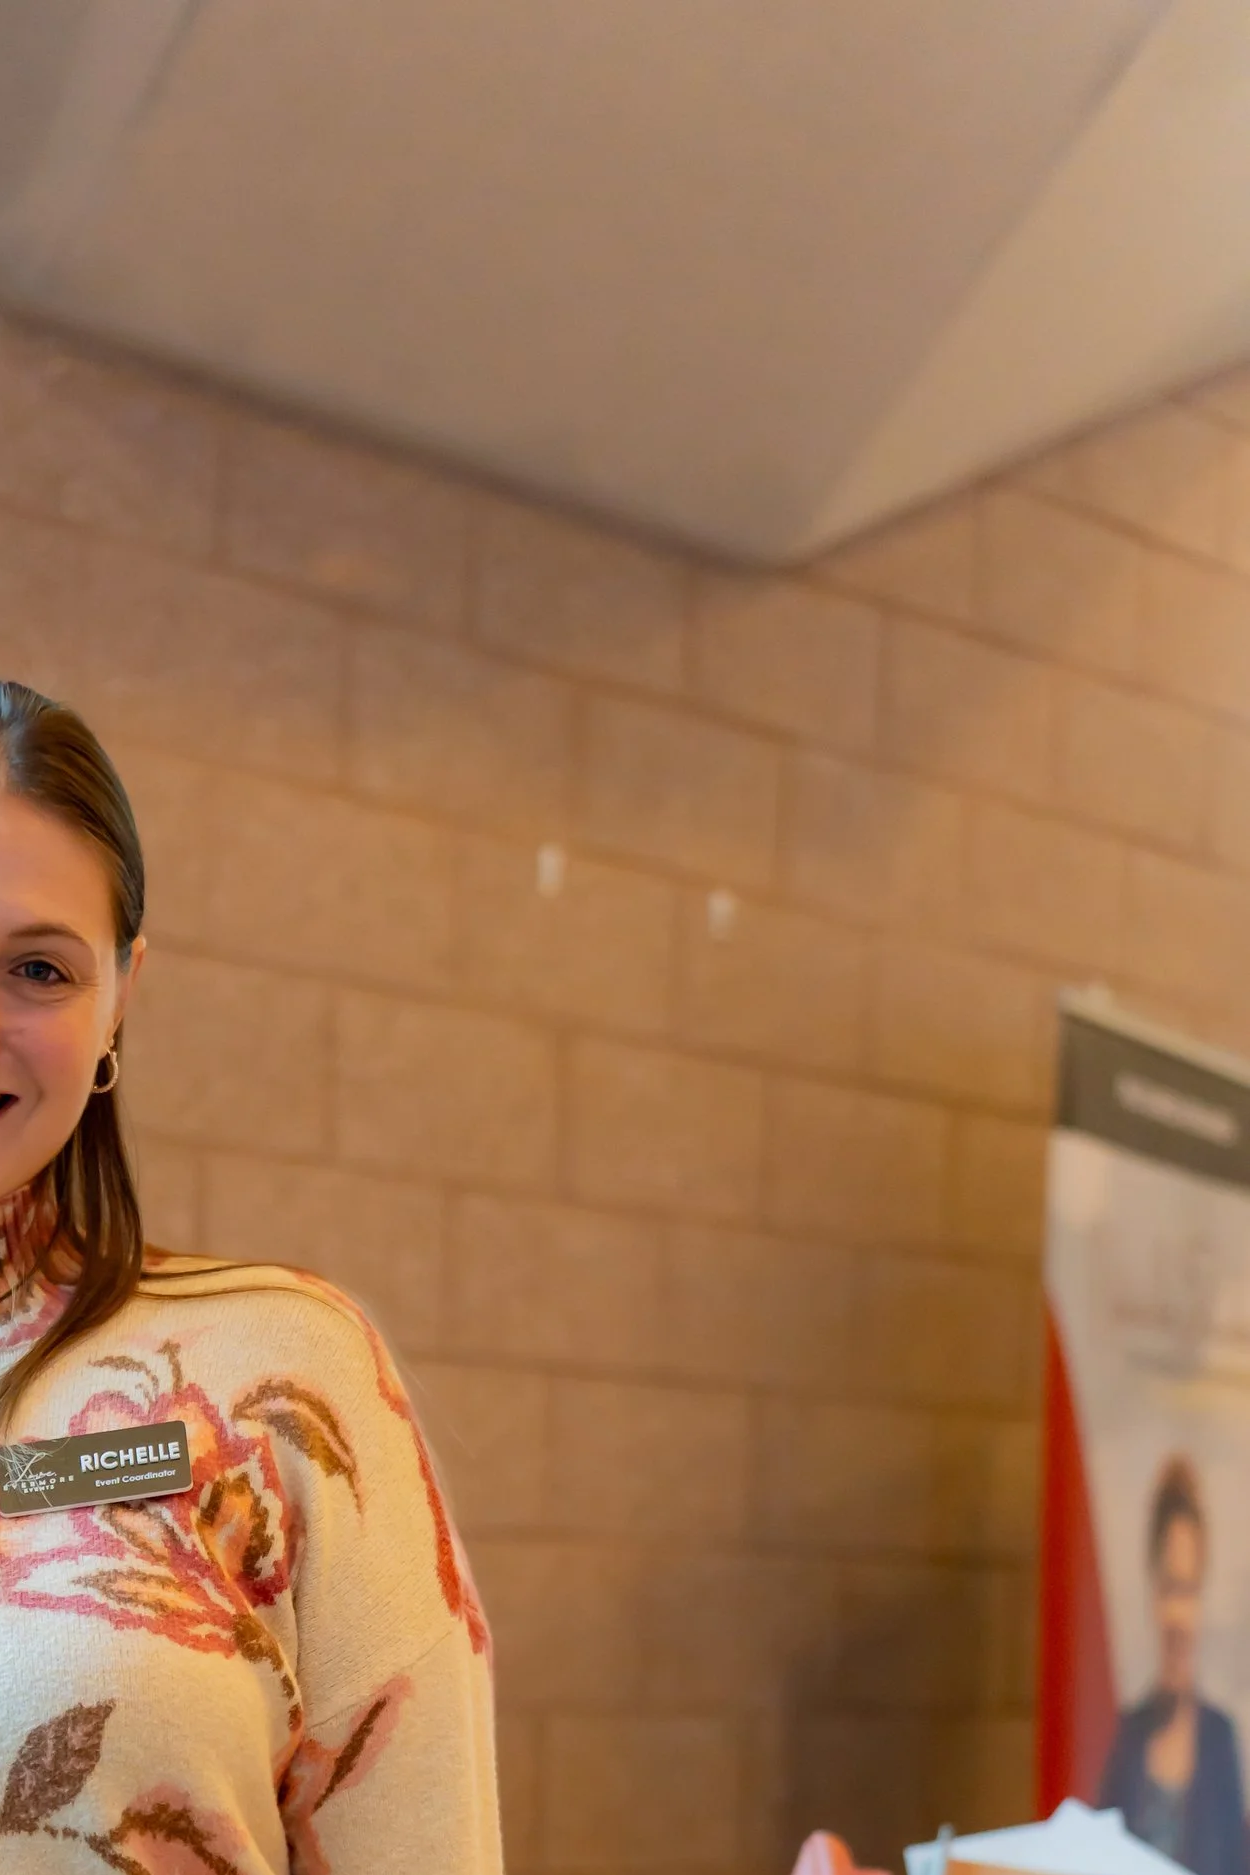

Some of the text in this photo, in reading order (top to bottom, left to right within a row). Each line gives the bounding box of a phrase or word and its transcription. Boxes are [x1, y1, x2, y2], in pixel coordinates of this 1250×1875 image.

[80, 1441, 180, 1472] RICHELLE
[3, 1475, 74, 1491] EVERMORE
[95, 1469, 176, 1487] Event Coordinator
